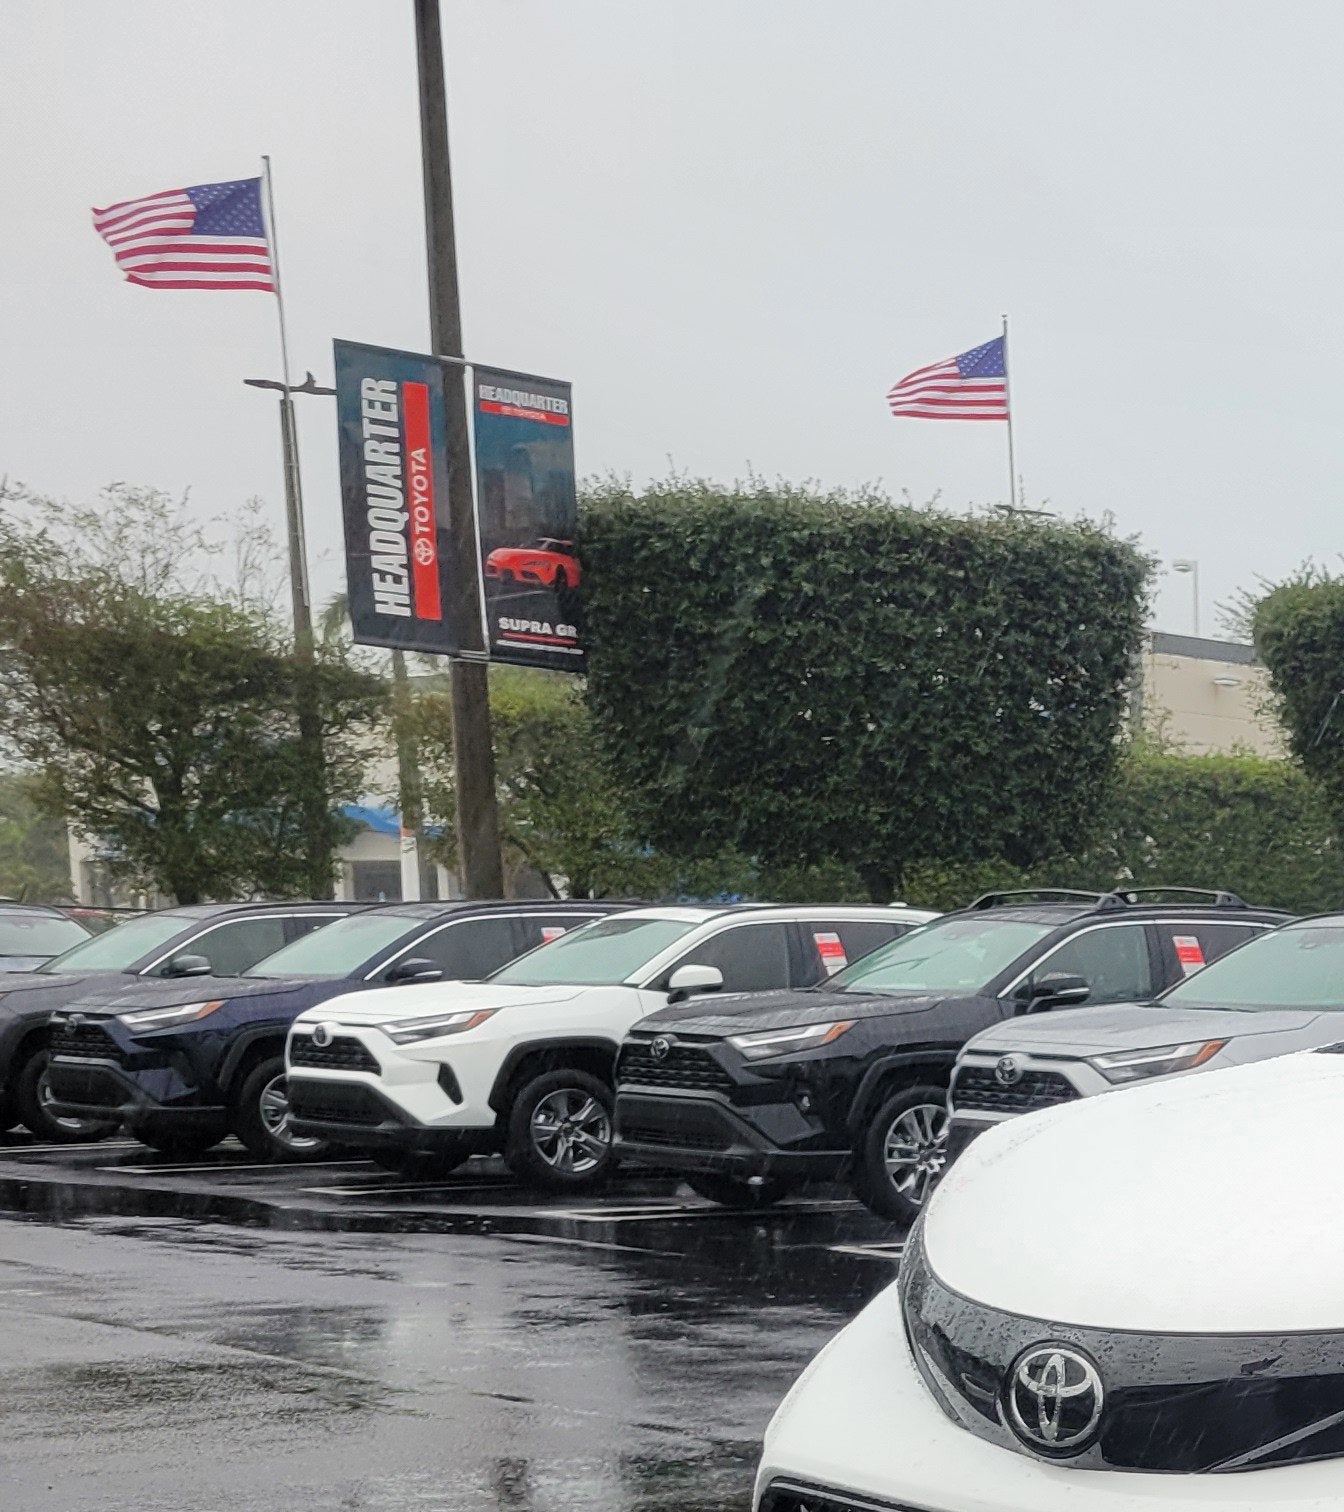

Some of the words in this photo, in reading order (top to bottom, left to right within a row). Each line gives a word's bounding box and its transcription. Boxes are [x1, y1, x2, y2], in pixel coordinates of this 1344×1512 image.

[479, 384, 569, 415] HEADQUARTER
[361, 377, 411, 618] HEADQUARTER
[410, 448, 431, 534] TOYOTA
[498, 617, 553, 634] SUPRA
[556, 623, 578, 637] GR
